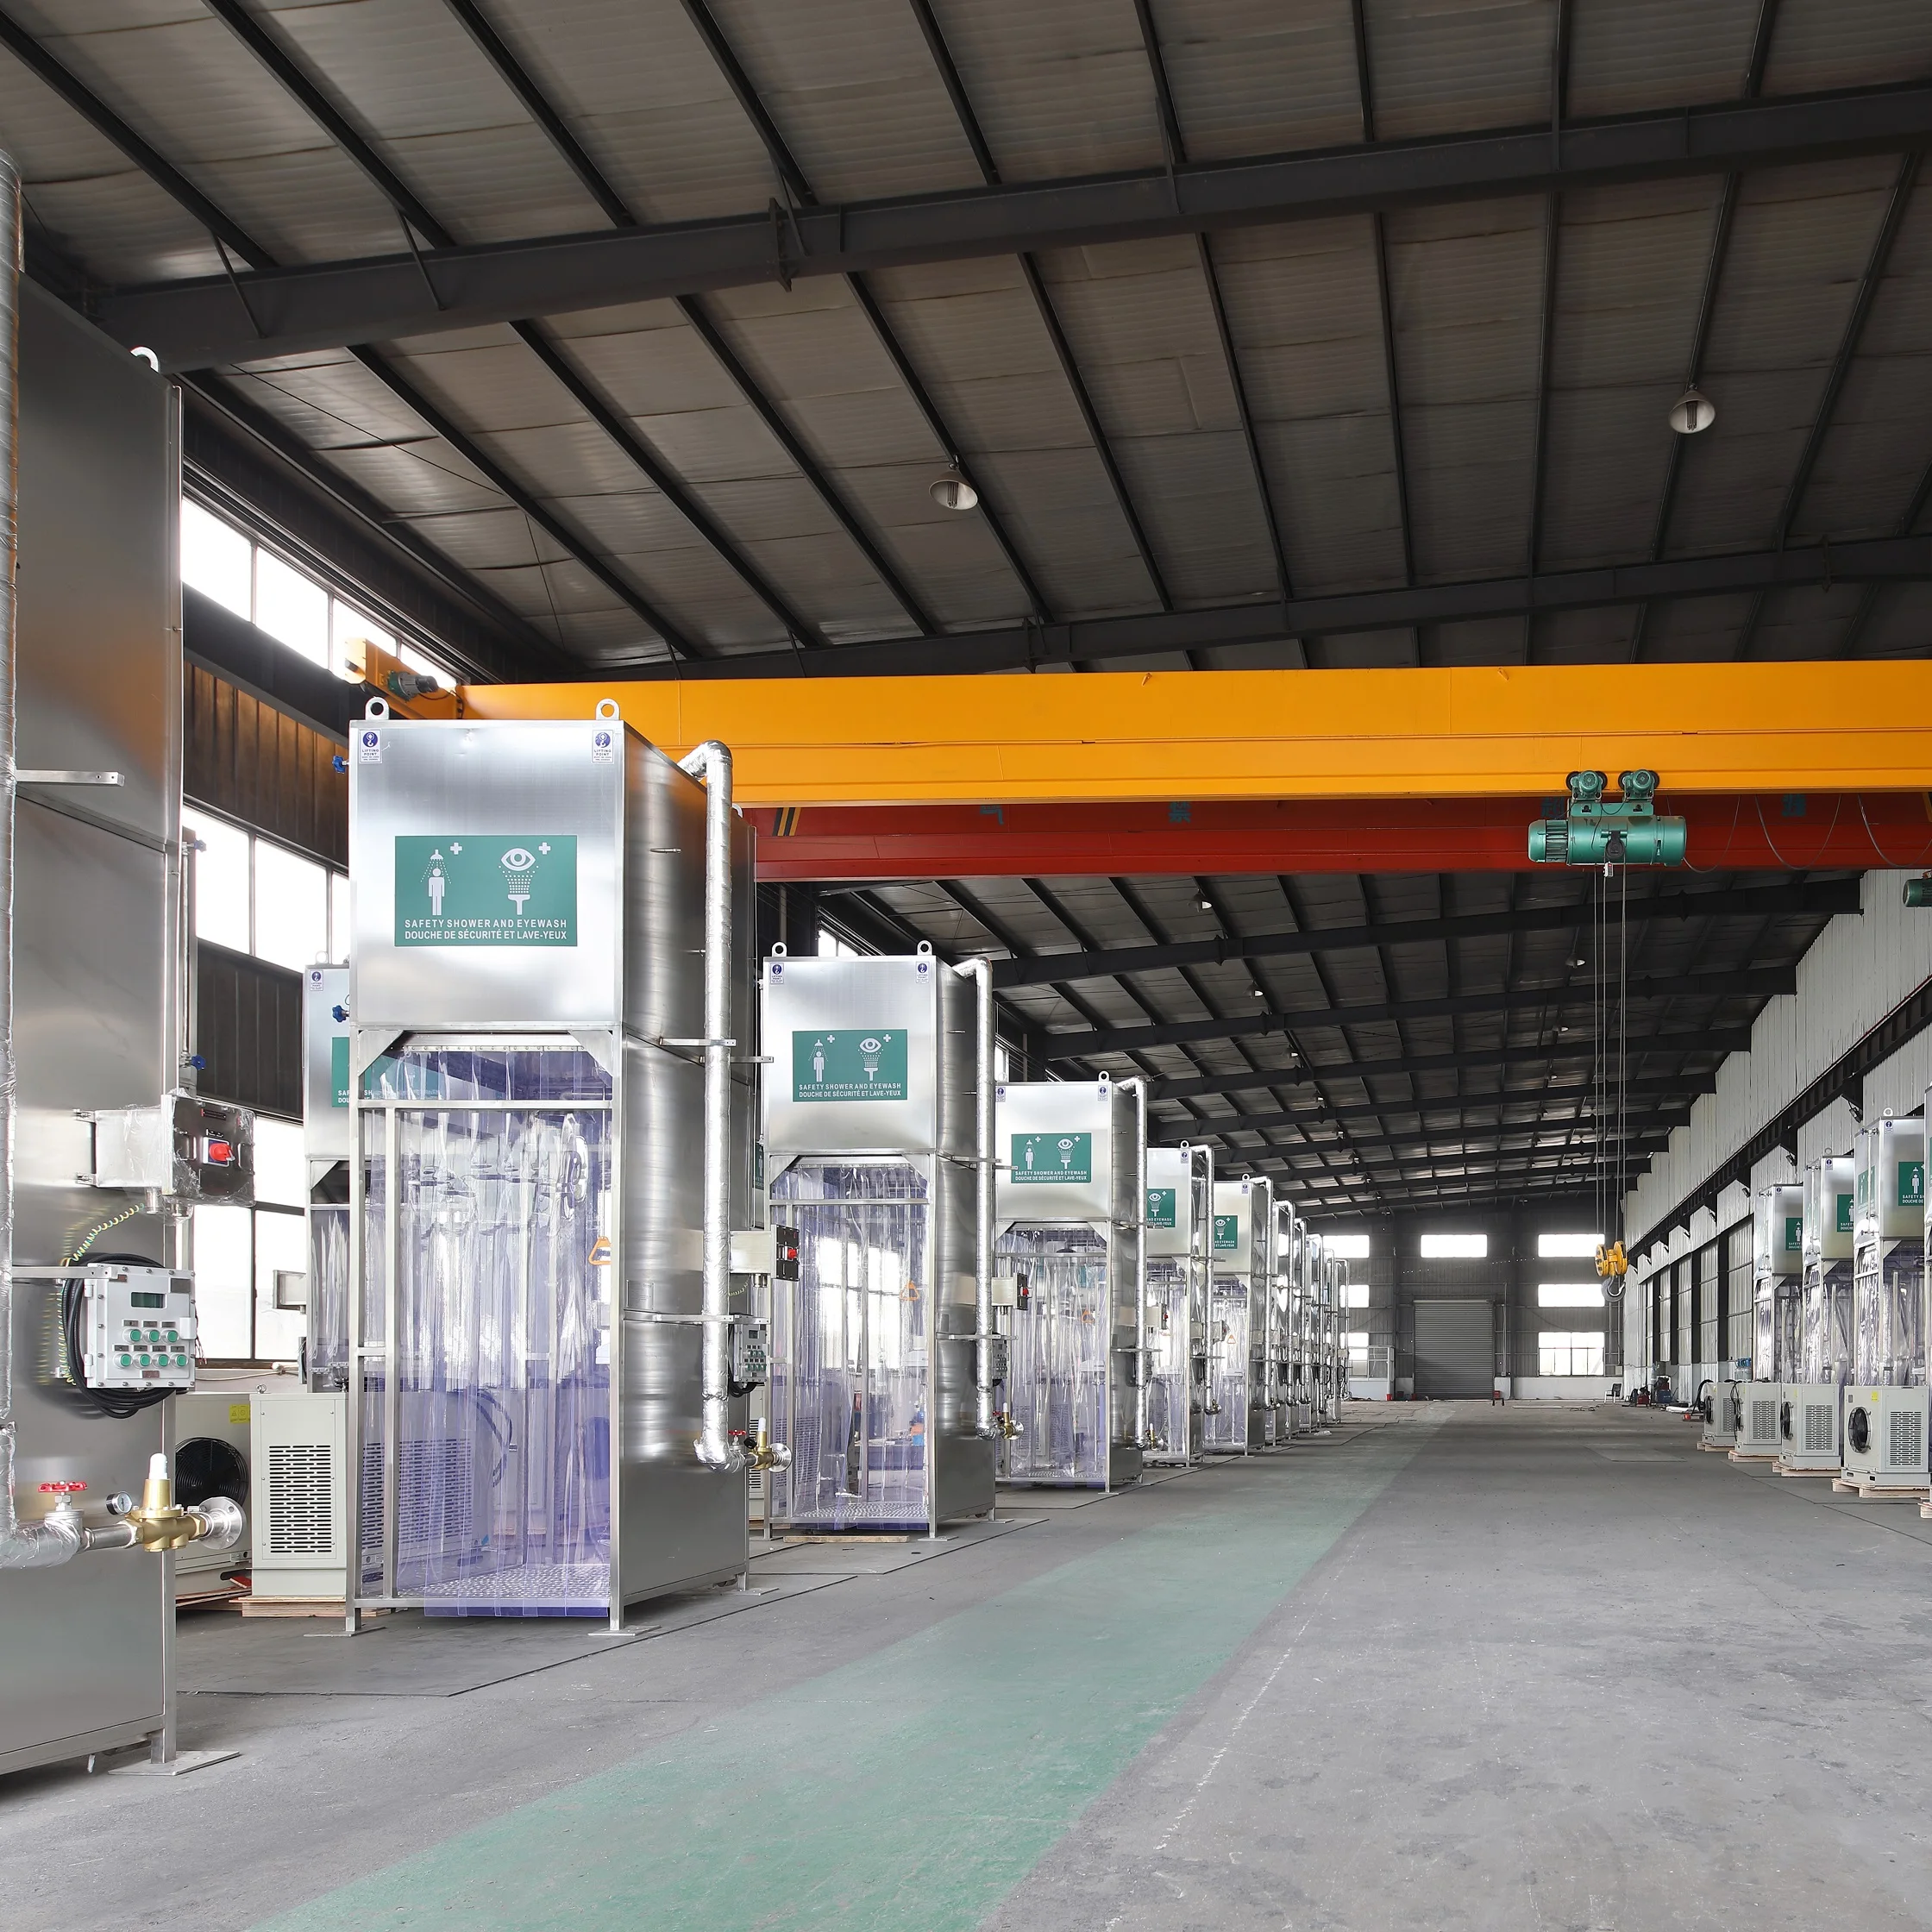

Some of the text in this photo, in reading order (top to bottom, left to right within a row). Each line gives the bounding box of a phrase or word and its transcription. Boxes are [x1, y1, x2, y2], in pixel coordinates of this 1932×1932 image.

[405, 919, 567, 928] SAFETY SHOWER AND EYEWASH
[405, 929, 567, 939] DOUCHE DE SÉCURITÉ ET LAVE-YEUX
